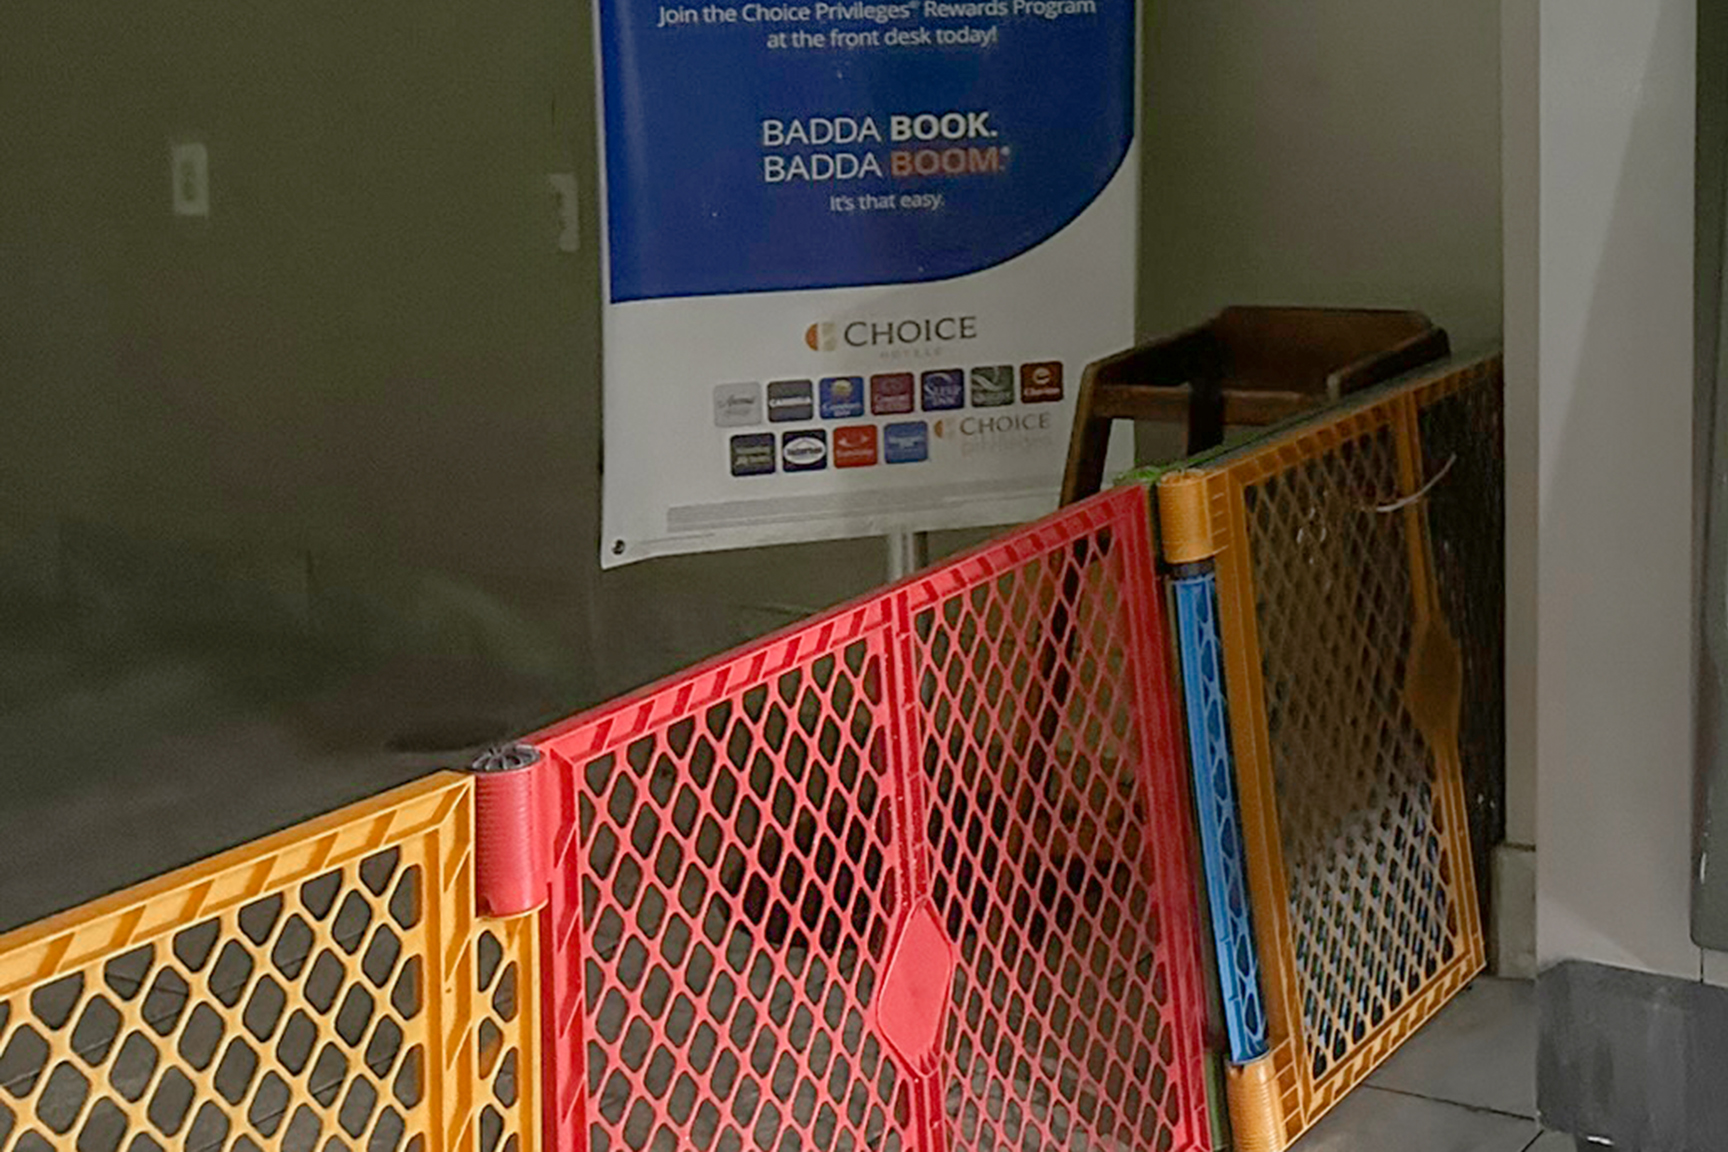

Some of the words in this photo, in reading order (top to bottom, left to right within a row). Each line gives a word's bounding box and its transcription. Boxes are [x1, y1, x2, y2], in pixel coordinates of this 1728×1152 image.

[658, 5, 697, 27] Join
[702, 4, 737, 23] the
[742, 3, 810, 22] Choice
[924, 0, 1007, 18] Rewards
[767, 32, 787, 47] at
[791, 30, 825, 47] the
[830, 29, 880, 46] front
[884, 28, 931, 45] desk
[936, 26, 998, 48] today!
[762, 117, 881, 147] BADDA
[891, 112, 998, 141] BOOK.
[763, 152, 882, 183] BADDA
[831, 195, 855, 212] It's
[859, 193, 896, 210] that
[900, 192, 945, 213] easy.
[844, 316, 977, 347] CHOICE
[960, 413, 1051, 436] CHOICE
